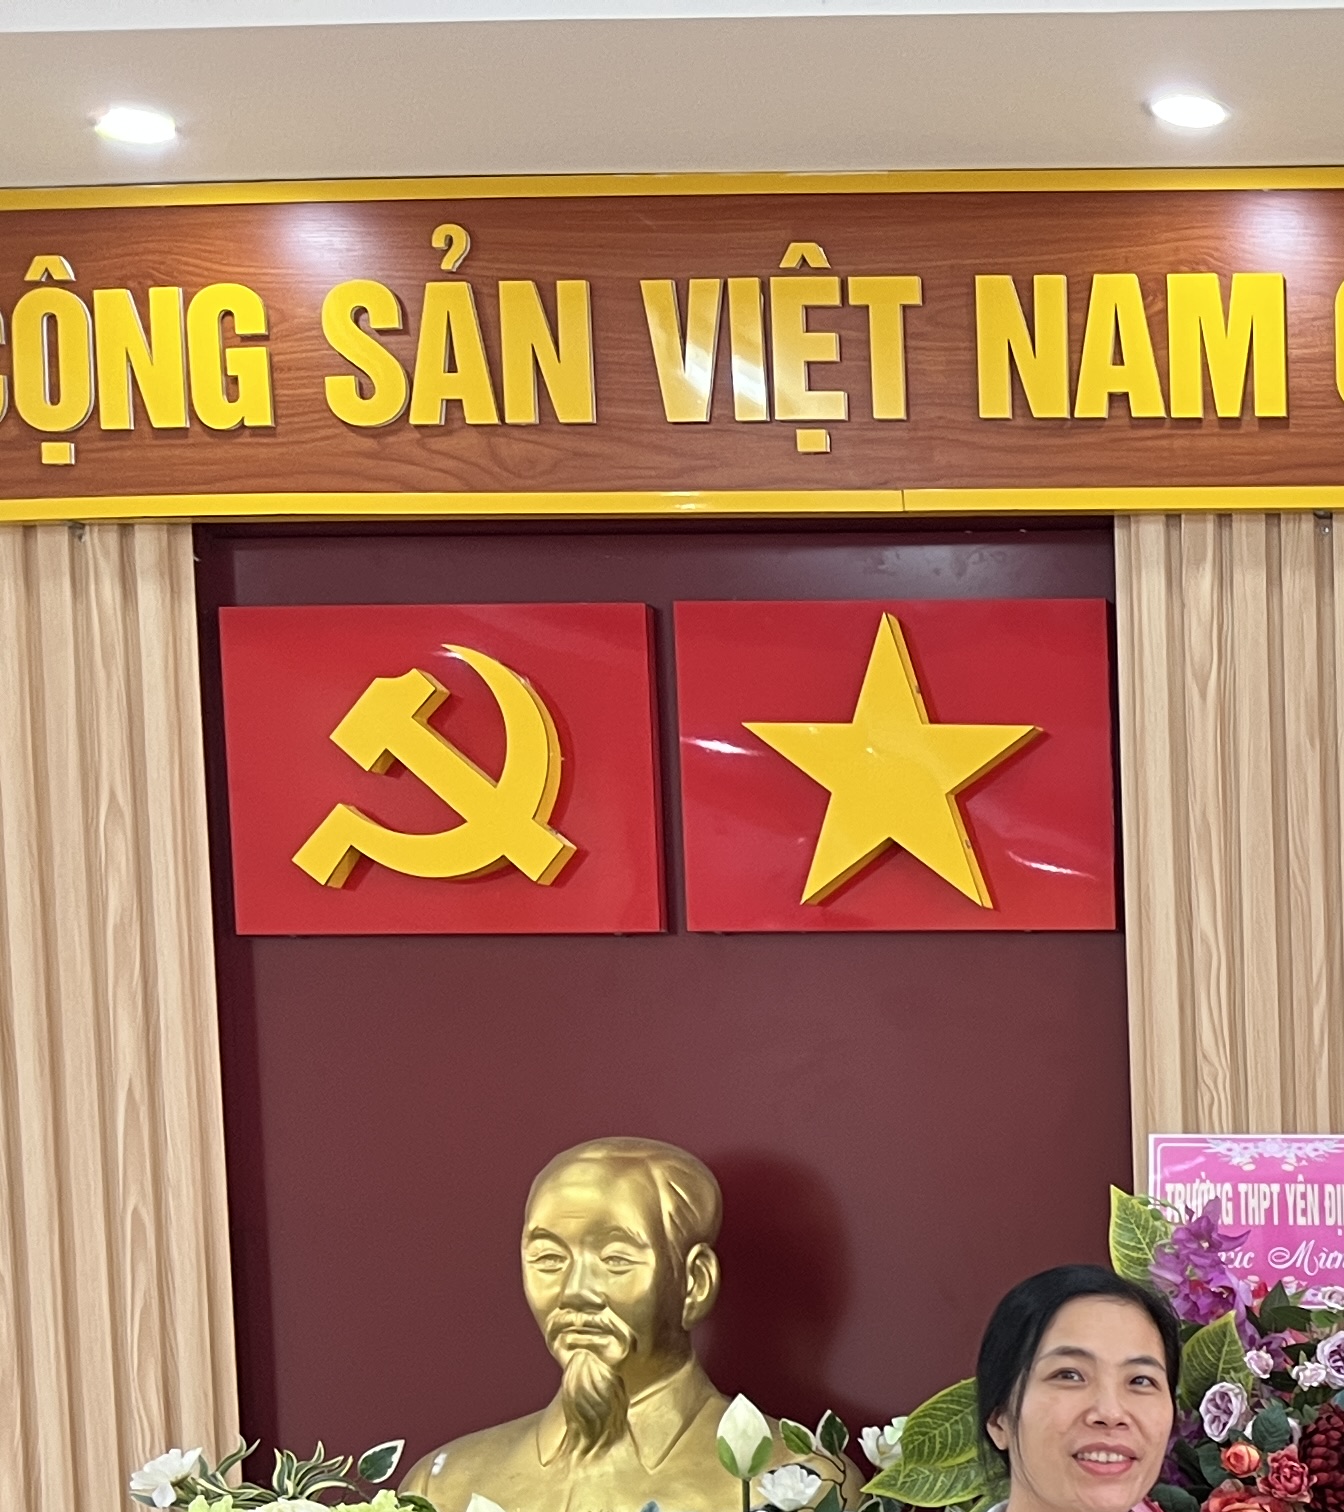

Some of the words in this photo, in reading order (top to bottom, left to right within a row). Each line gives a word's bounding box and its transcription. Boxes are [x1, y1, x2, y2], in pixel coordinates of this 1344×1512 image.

[0, 255, 276, 465] ỘNG
[321, 223, 598, 428] SẢN
[639, 242, 922, 453] VIỆT
[974, 272, 1289, 419] NAM
[1237, 1182, 1281, 1226] THPT
[1284, 1174, 1320, 1226] YÊN
